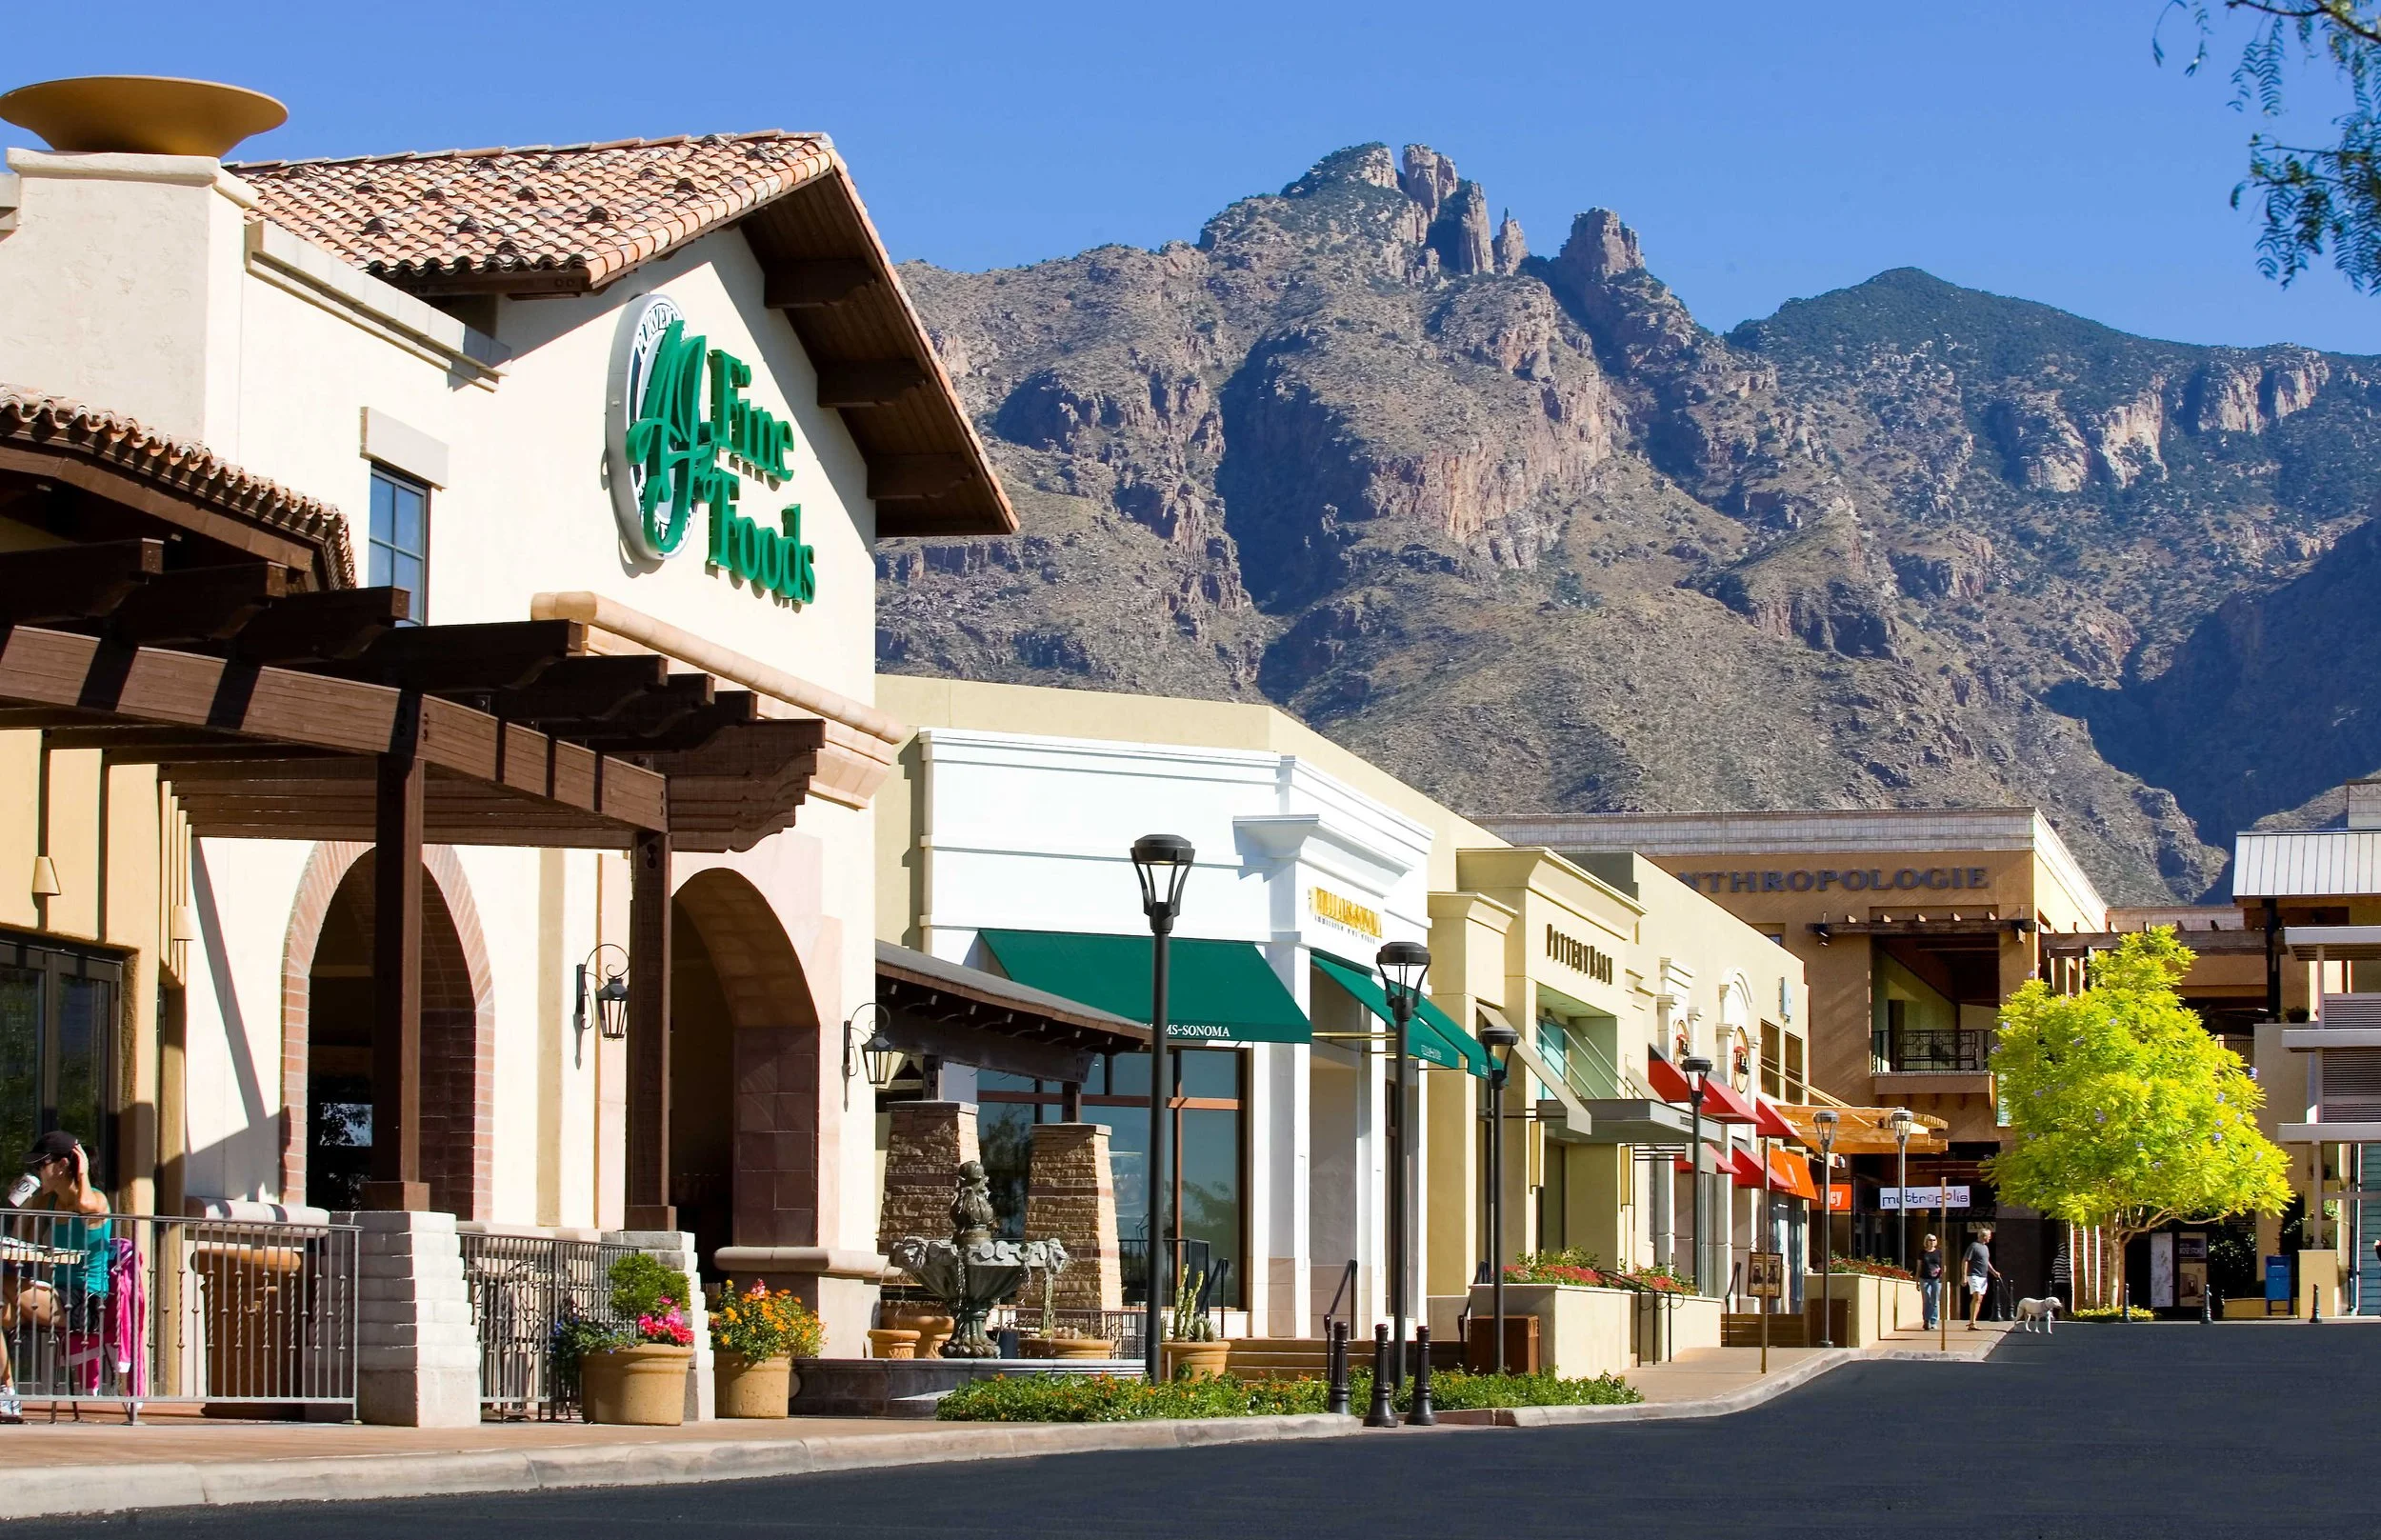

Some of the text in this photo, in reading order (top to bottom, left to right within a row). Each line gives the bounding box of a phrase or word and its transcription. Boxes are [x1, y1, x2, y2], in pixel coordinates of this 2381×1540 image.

[708, 349, 793, 482] Fine
[709, 468, 815, 605] Foods
[1677, 867, 1990, 892] NTHROPOLOGIE
